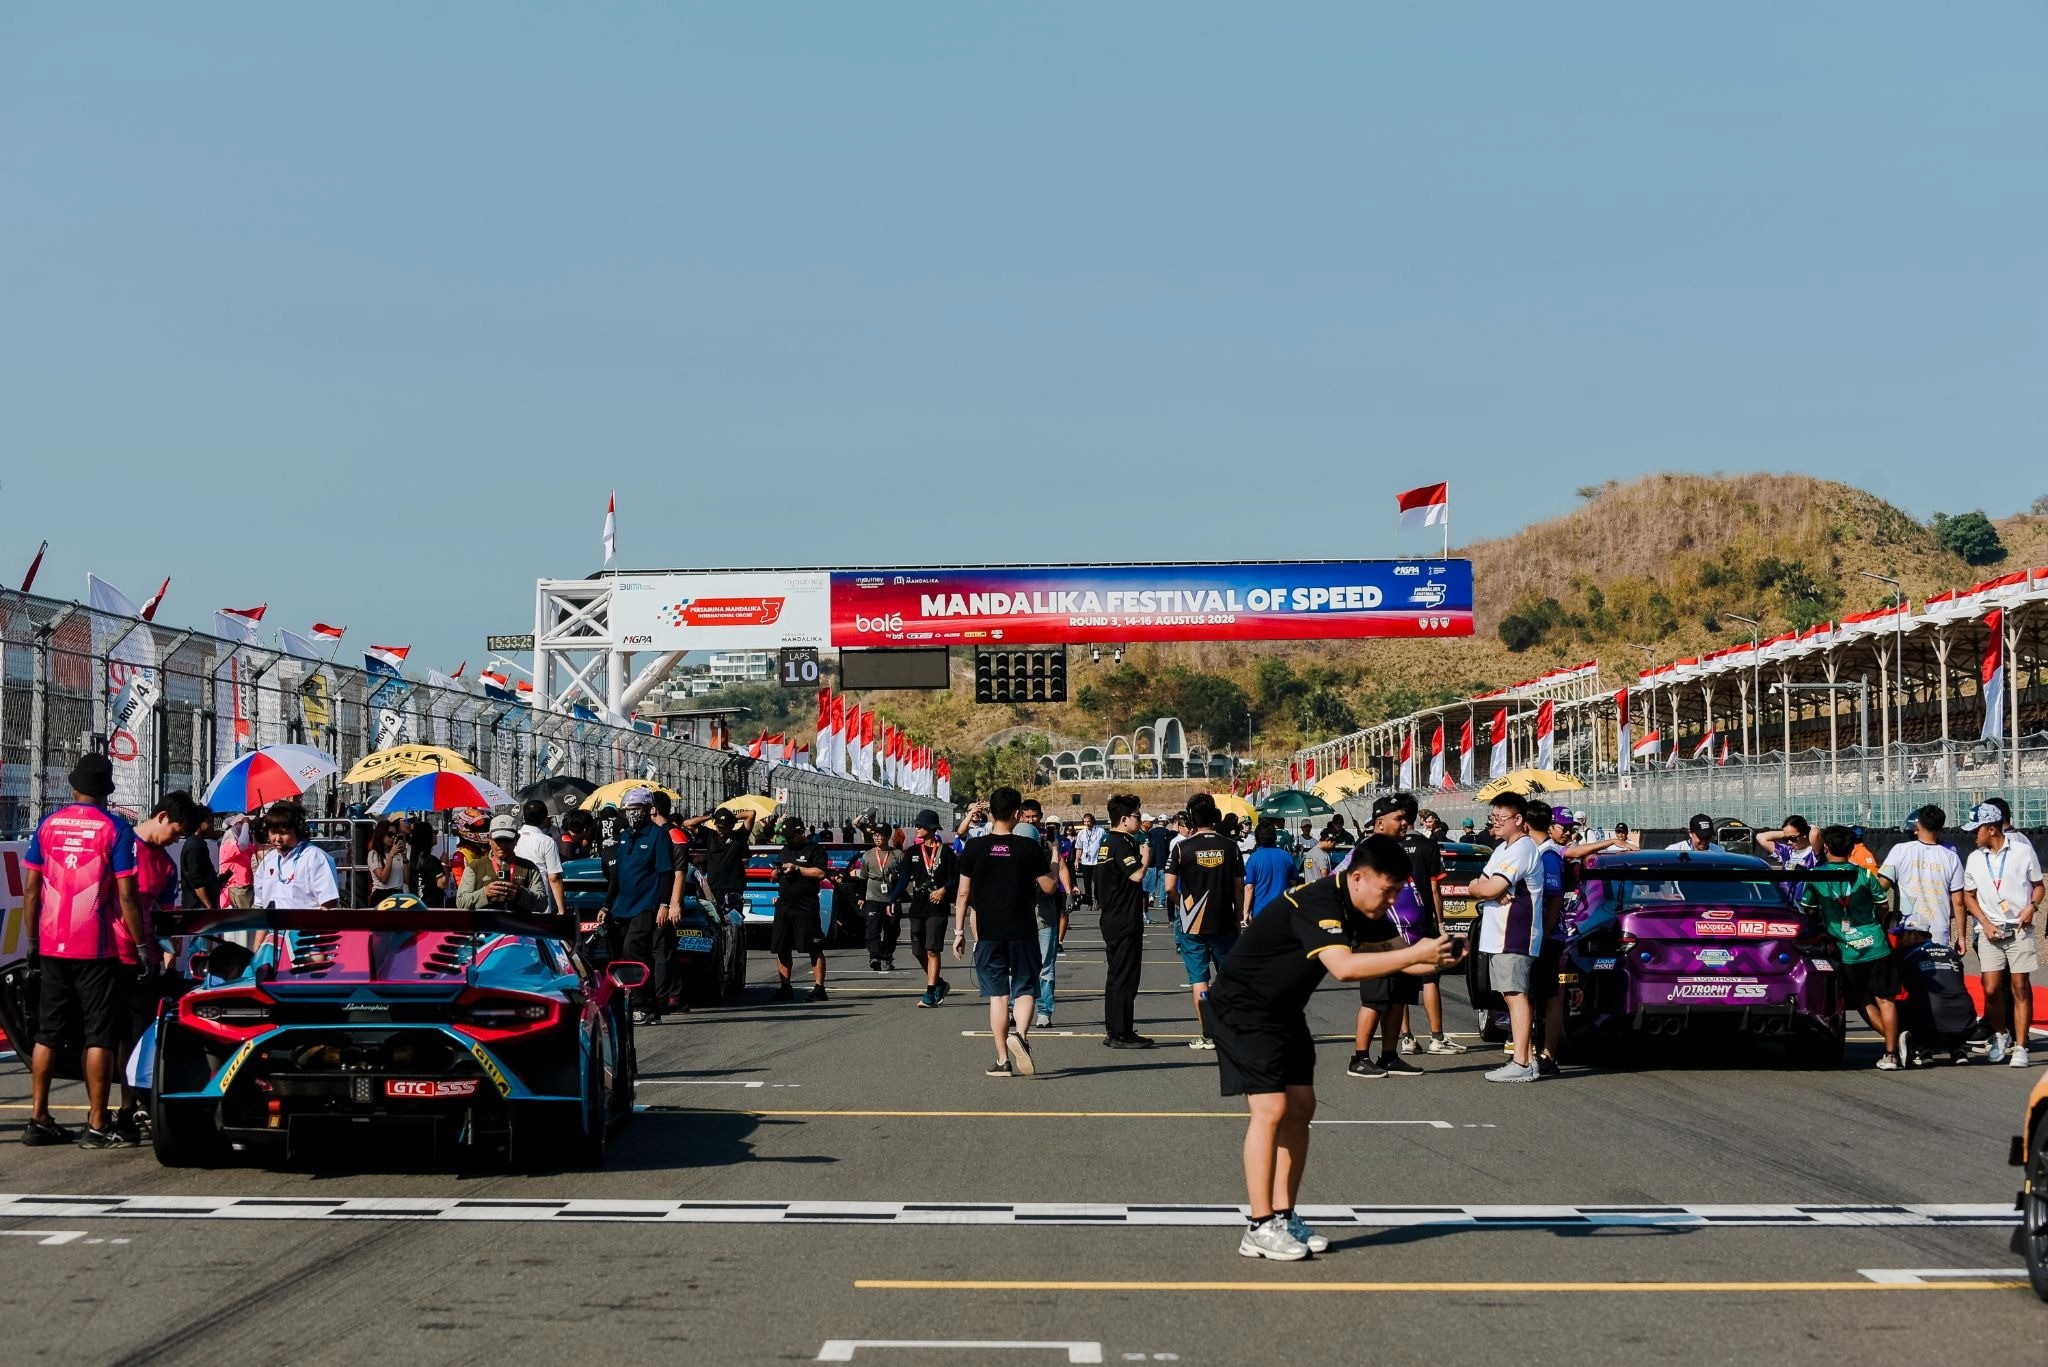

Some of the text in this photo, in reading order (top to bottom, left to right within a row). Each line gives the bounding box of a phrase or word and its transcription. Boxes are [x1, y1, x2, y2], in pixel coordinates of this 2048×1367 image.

[1395, 566, 1420, 575] MGPA
[921, 585, 1383, 617] MANDALIKA FESTIVAL OF SPEED
[855, 612, 904, 633] balé
[1069, 614, 1235, 628] ROUND 3, 14-16 AGUSTUS 2026
[488, 636, 533, 650] 15:33:25
[623, 636, 652, 644] MGPA
[789, 652, 810, 661] LAPS
[784, 660, 818, 682] 10
[118, 697, 139, 723] ROW
[136, 683, 150, 698] 4
[374, 725, 389, 745] ROW
[384, 715, 396, 726] 3
[550, 745, 559, 755] 2
[363, 751, 412, 768] Giti
[1697, 924, 1733, 932] MAXDECAL
[1740, 923, 1798, 935] M2 SSS
[1691, 985, 1733, 994] TROPHY
[1734, 985, 1769, 998] SSS
[341, 1003, 390, 1011] Lamborghini
[474, 1048, 499, 1080] Giti
[222, 1058, 241, 1089] Giti
[393, 1080, 479, 1095] GTC SSS
